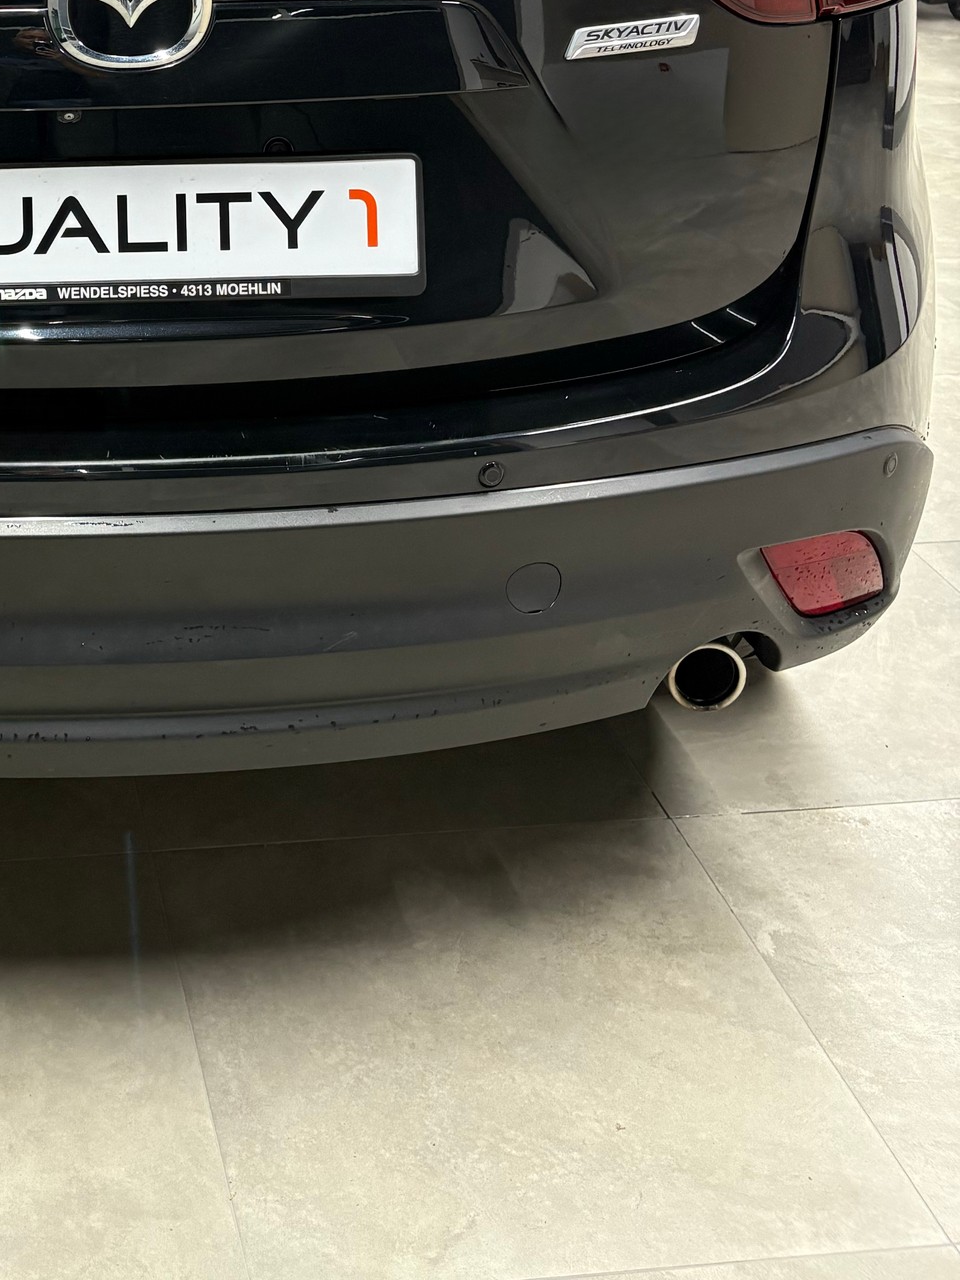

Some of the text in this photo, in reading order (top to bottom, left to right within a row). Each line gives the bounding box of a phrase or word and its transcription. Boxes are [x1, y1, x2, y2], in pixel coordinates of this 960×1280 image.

[584, 20, 689, 42] SKYACTIV
[596, 38, 674, 53] TECHNOLOGY
[348, 188, 378, 248] 1
[57, 285, 169, 300] WENDELSPIESS
[180, 284, 212, 297] 4313
[216, 282, 282, 296] MOEHLIN
